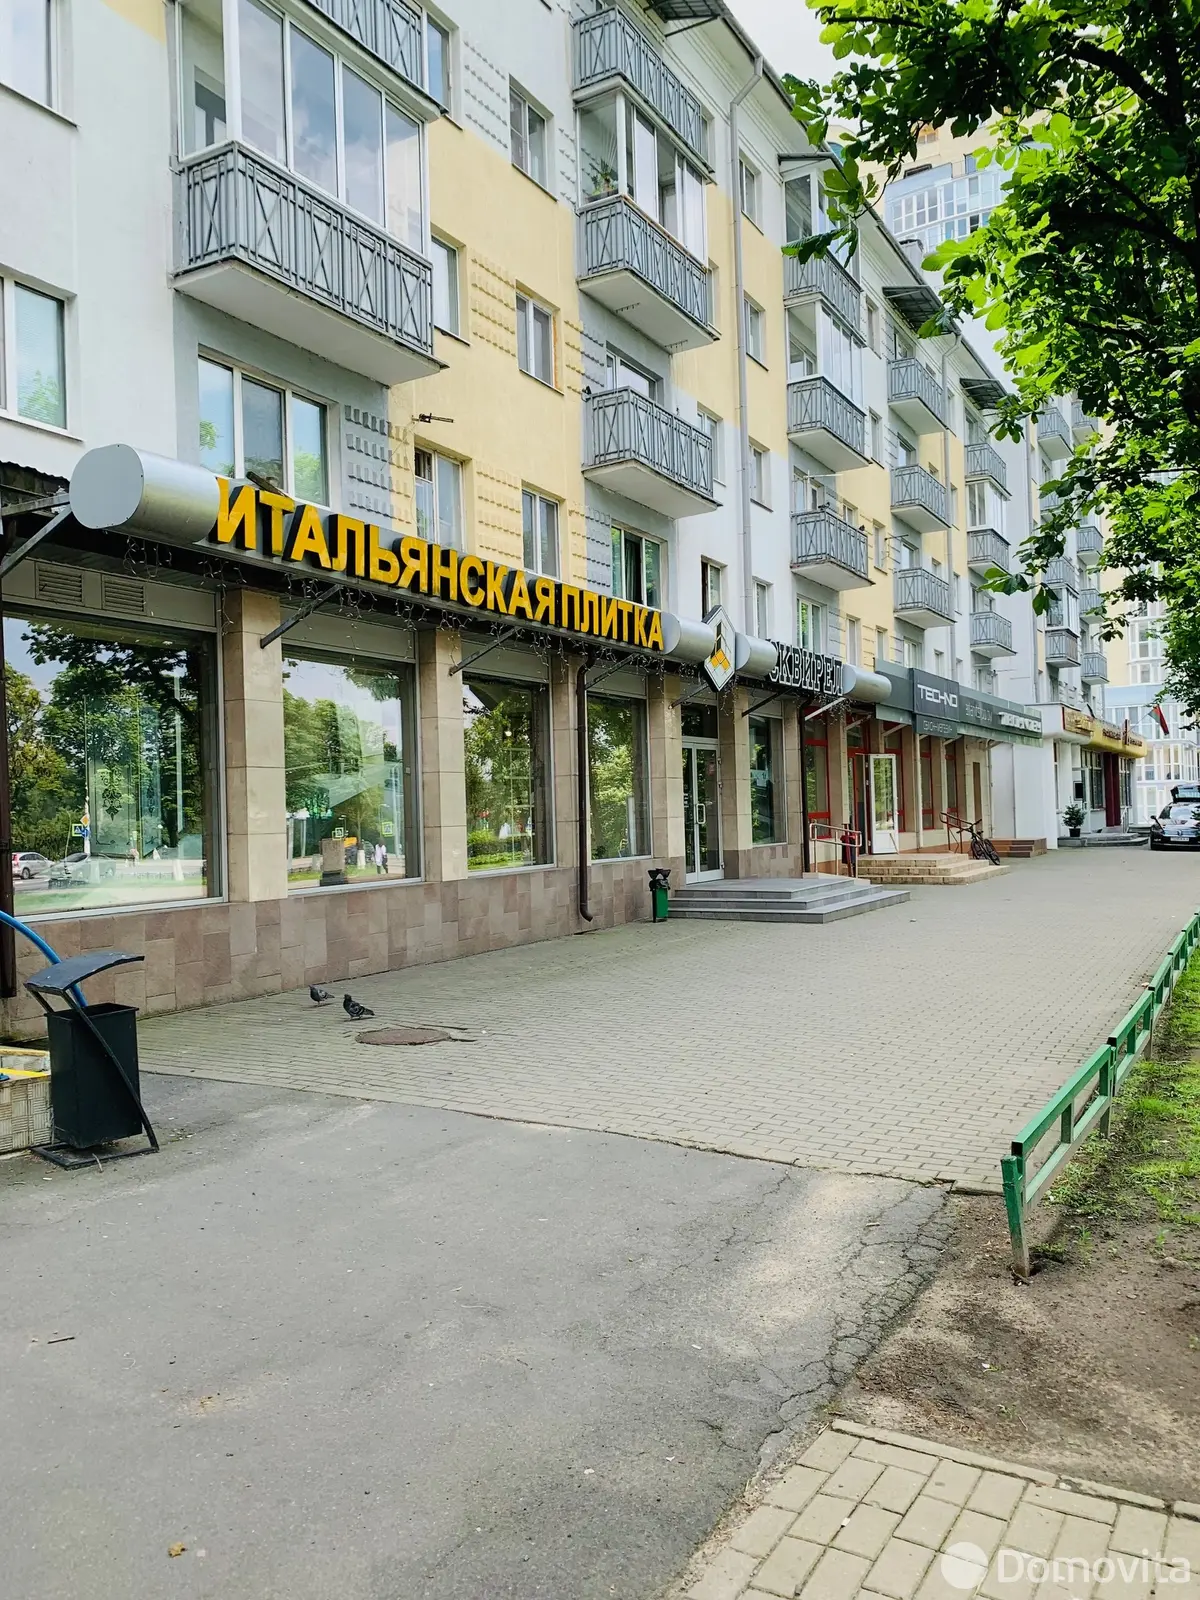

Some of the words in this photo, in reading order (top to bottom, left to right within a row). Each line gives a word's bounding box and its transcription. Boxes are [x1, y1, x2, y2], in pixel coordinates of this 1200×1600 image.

[213, 476, 557, 625] ИТАЛЬЯНСКАЯ
[560, 586, 665, 650] ПЛИТКА
[917, 684, 958, 708] TECHNO
